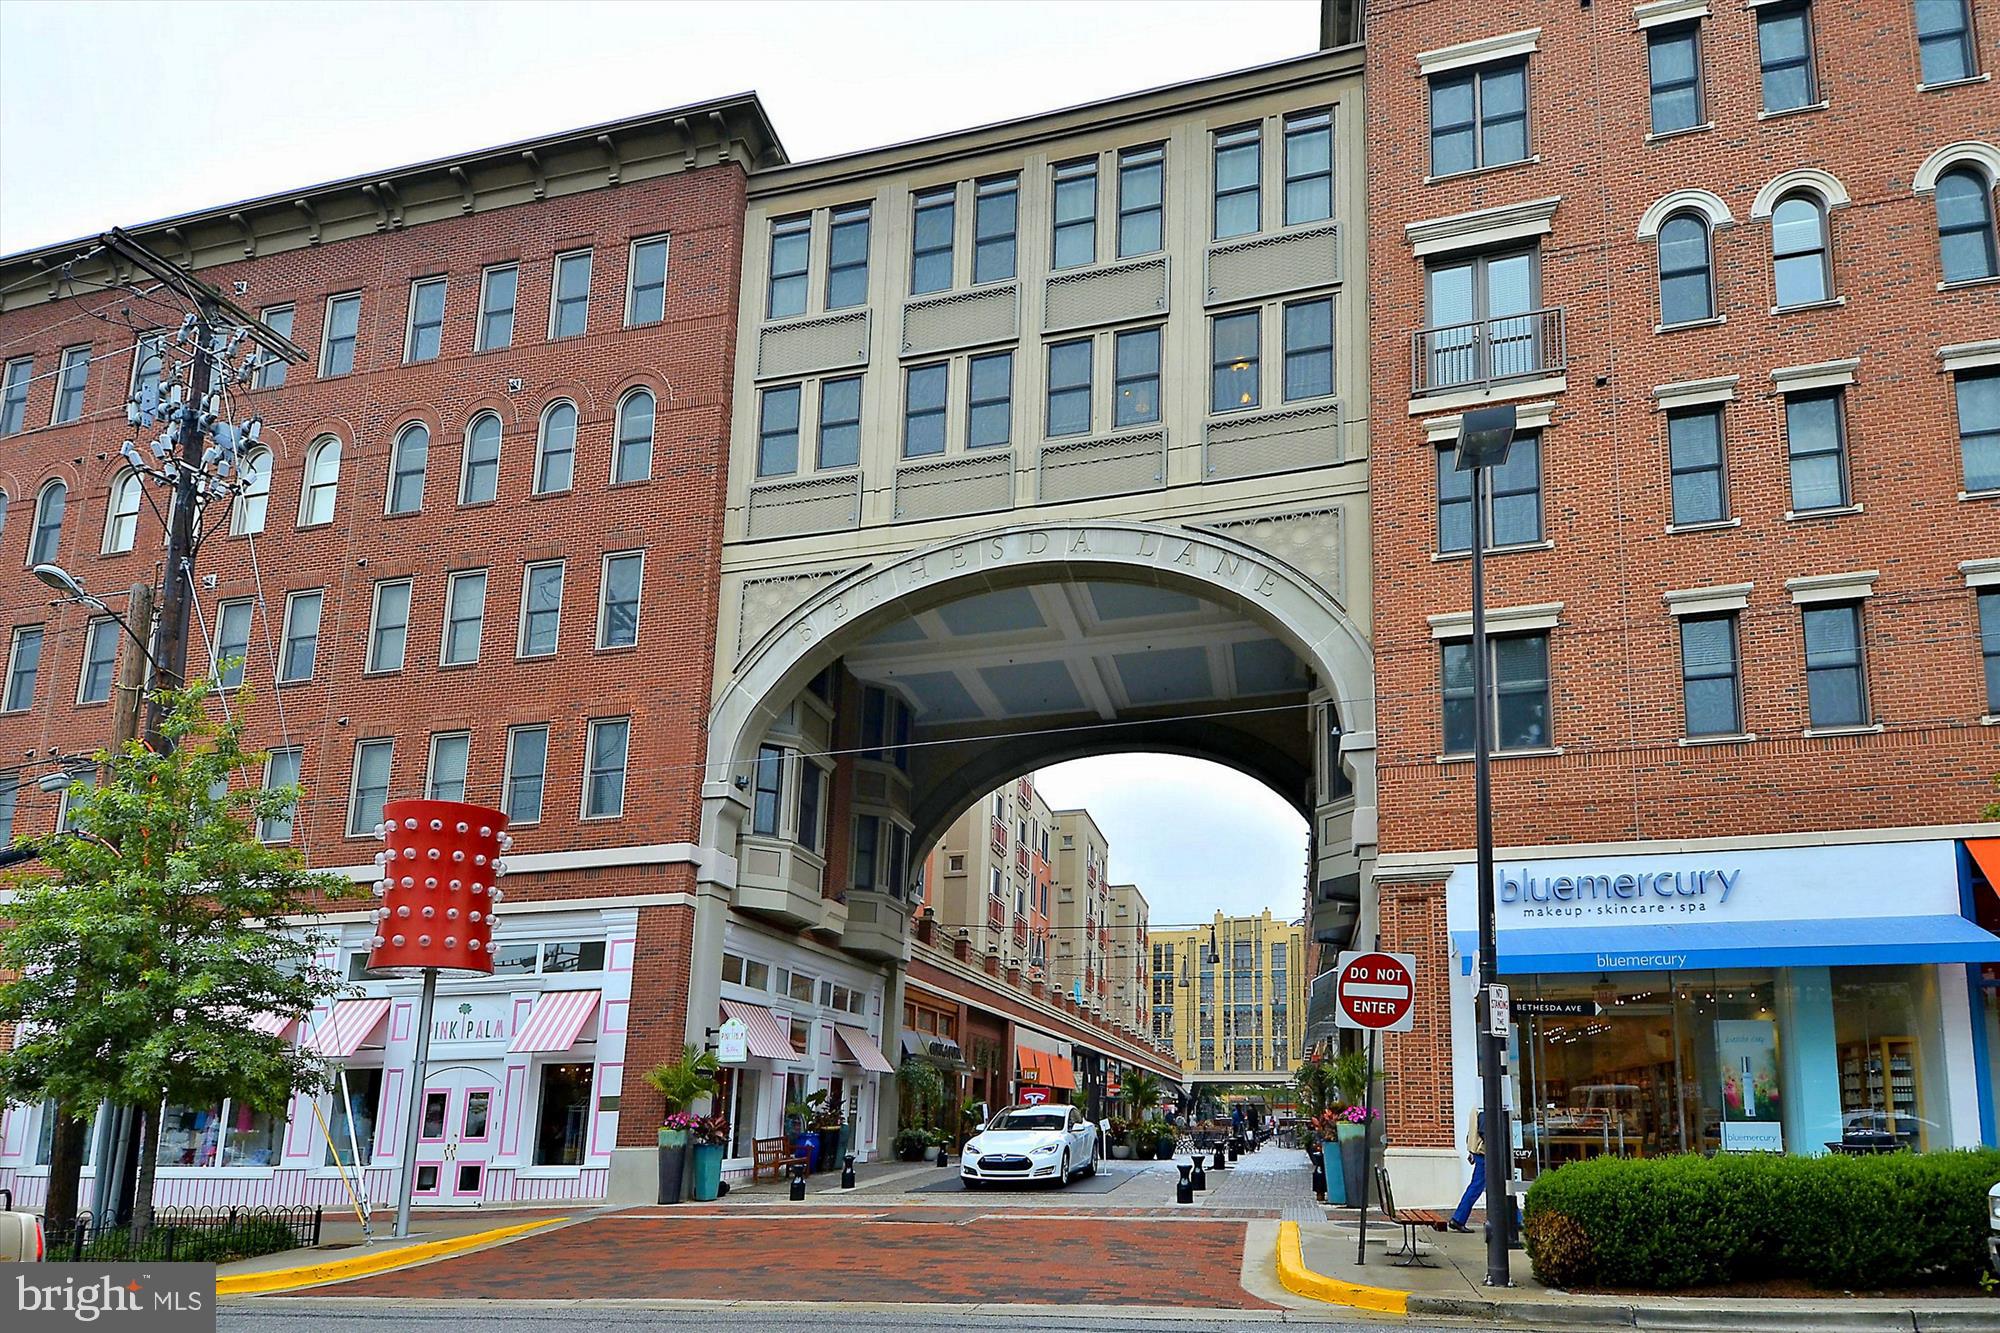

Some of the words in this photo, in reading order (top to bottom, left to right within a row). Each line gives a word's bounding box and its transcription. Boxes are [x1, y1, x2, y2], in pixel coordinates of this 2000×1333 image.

[792, 530, 1091, 646] BETHESDA
[1136, 533, 1280, 597] LANE
[1500, 868, 1741, 904] bluemercury
[1523, 906, 1583, 918] makeup
[1597, 903, 1665, 915] skincare
[1680, 901, 1707, 914] spa
[1597, 953, 1687, 968] bluemercury
[1350, 966, 1369, 980] DO
[1376, 968, 1403, 981] NOT
[1353, 1000, 1396, 1014] ENTER
[1516, 1003, 1562, 1012] BETHESDA
[1564, 1004, 1582, 1012] AVE
[430, 1021, 457, 1040] INK
[466, 1019, 504, 1039] PALM
[1727, 1133, 1777, 1142] bluemercury
